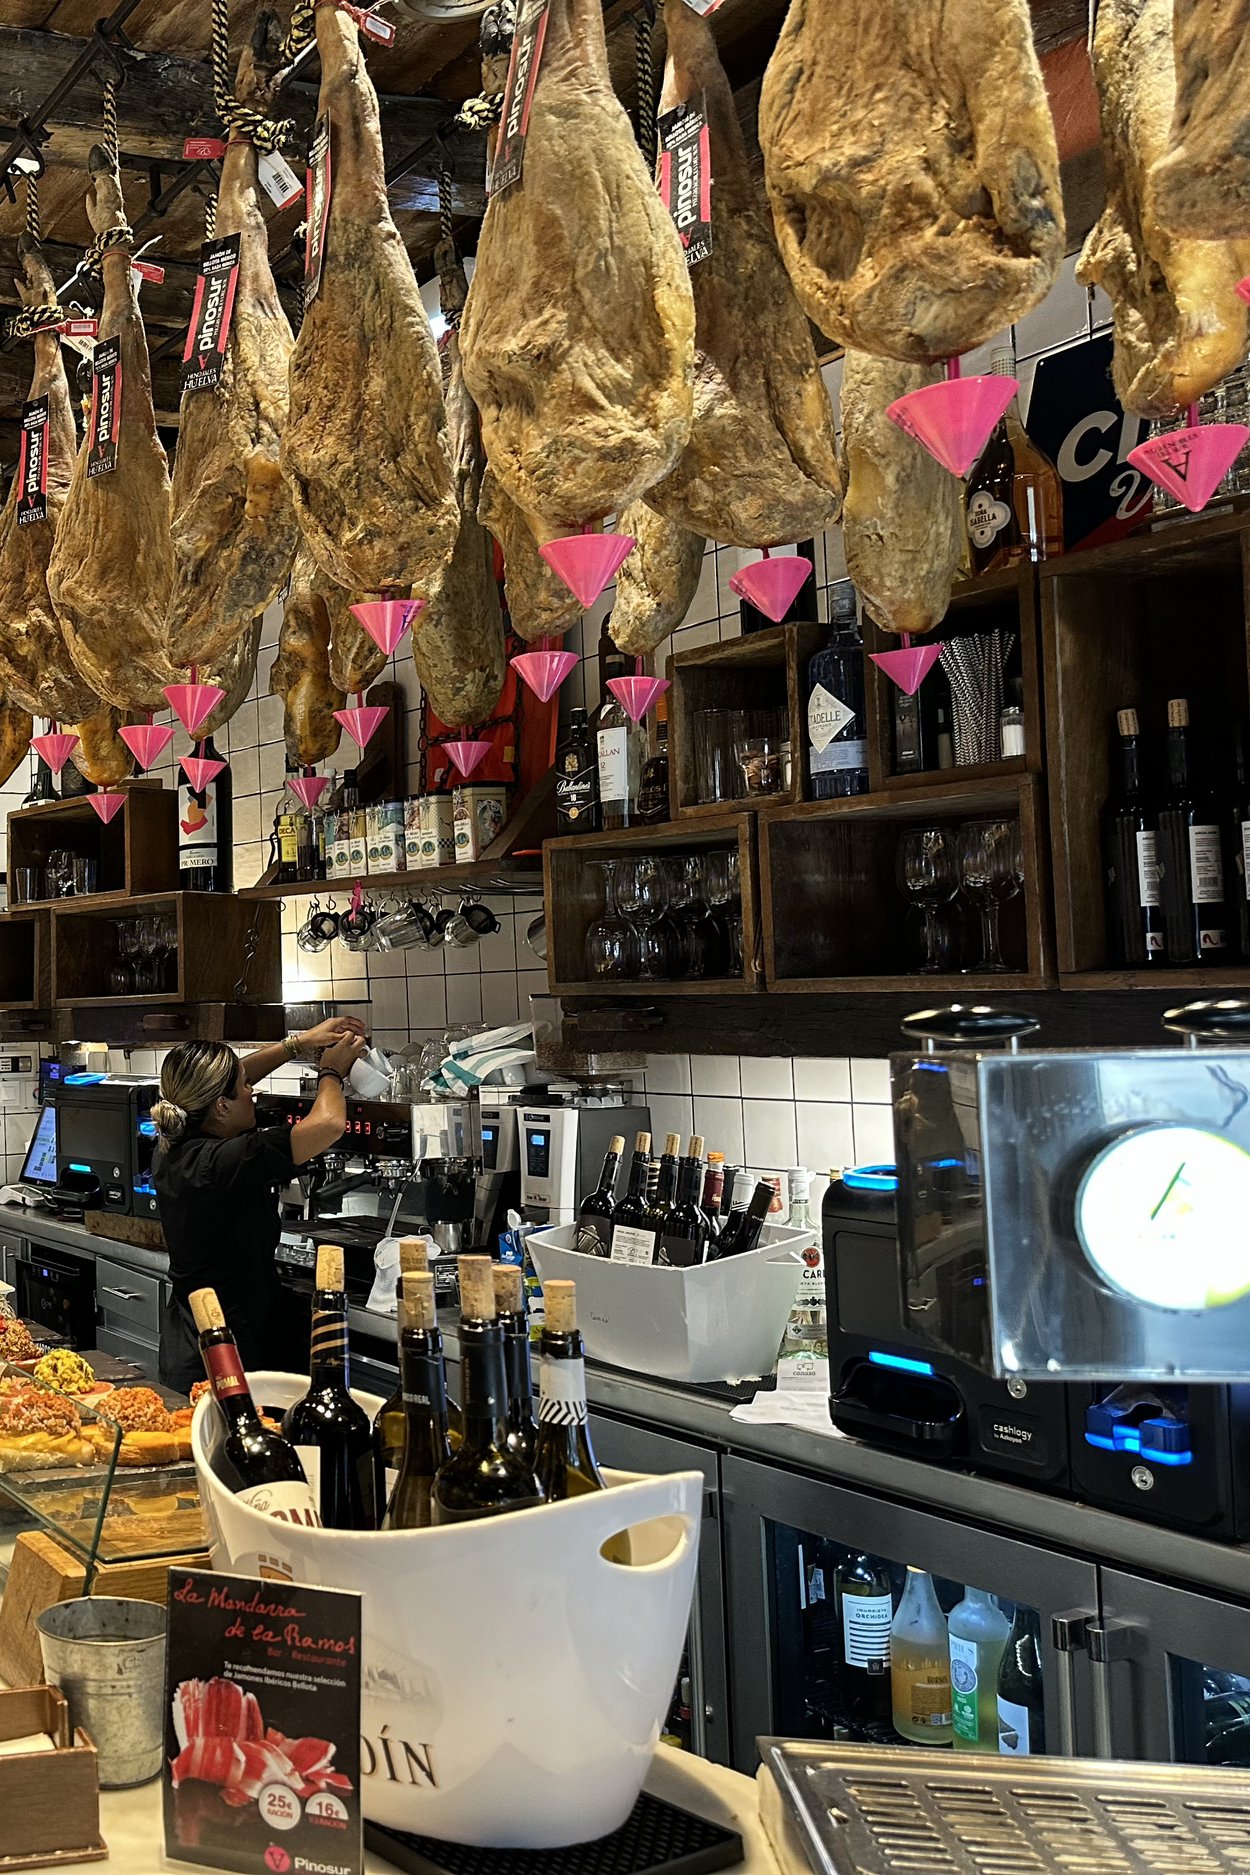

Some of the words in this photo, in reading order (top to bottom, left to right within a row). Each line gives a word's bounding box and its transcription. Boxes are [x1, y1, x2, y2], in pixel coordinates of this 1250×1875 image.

[507, 34, 532, 138] pinosur
[673, 147, 697, 229] pinosur
[685, 246, 709, 266] ELVA
[198, 276, 223, 351] pinosur
[184, 374, 218, 390] HUELVA
[97, 374, 110, 442] pinosur
[26, 431, 40, 492] pinosur
[970, 513, 997, 528] ISABELLA
[181, 858, 214, 867] PRMERO
[216, 1375, 240, 1391] POMAL
[994, 1424, 1032, 1441] cashlogy
[174, 1578, 205, 1604] La
[207, 1586, 306, 1617] Mandarra
[855, 1612, 888, 1620] ORCHIDEA
[224, 1617, 245, 1638] de
[252, 1624, 282, 1642] la
[284, 1623, 356, 1655] Ramos
[292, 1650, 347, 1668] Restaurante
[224, 1661, 232, 1669] Te
[232, 1662, 285, 1677] recomendamos
[286, 1671, 312, 1682] nuestra
[313, 1674, 346, 1687] selección
[224, 1670, 232, 1678] de
[233, 1672, 263, 1683] Jamones
[264, 1675, 291, 1687] Ibéricos
[292, 1680, 317, 1691] Bellota
[267, 1793, 292, 1810] 25€
[316, 1802, 340, 1818] 16€
[267, 1808, 293, 1819] RACIÓN
[294, 1857, 350, 1875] Pinosur
